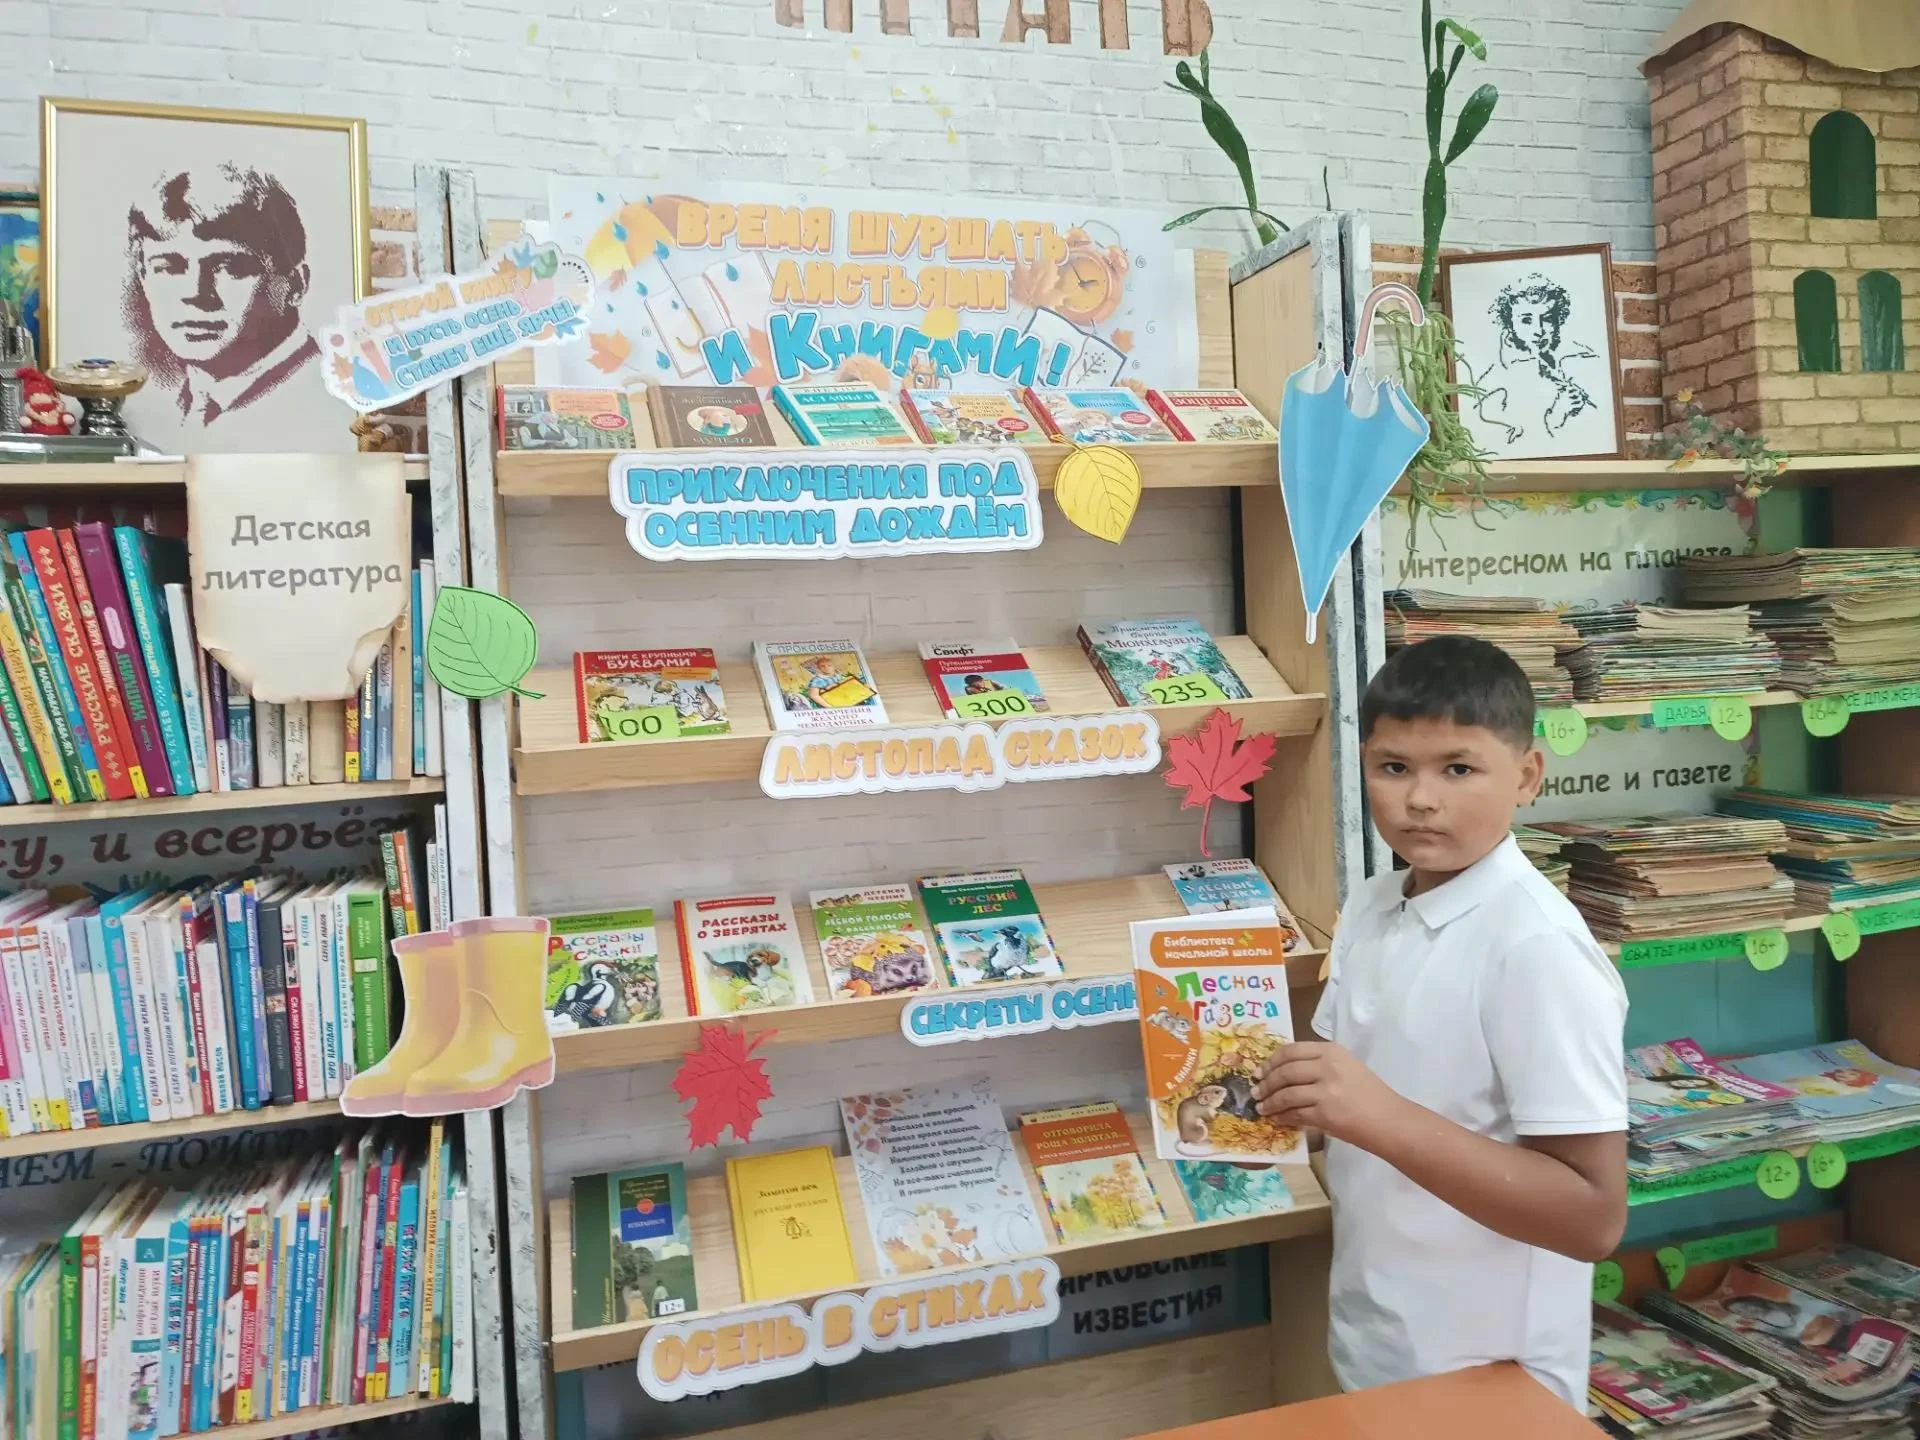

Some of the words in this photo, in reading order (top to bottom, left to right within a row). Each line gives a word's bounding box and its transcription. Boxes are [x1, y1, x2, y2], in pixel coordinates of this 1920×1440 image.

[675, 203, 835, 254] ВРЕМЯ
[849, 212, 1069, 266] ШУРШАТЬ
[771, 261, 1010, 312] ЛИСТЬЯМИ
[386, 335, 405, 356] И
[406, 317, 462, 349] ПУСТЬ
[464, 299, 521, 329] ОСЕНЬ
[396, 343, 469, 387] СТАНЕТ
[517, 299, 575, 337] ЯРЧЕ!
[627, 463, 928, 504] ПРИКЛЮЧЕНИЯ
[938, 461, 1023, 498] ПОД
[231, 514, 371, 546] Детская
[644, 510, 837, 548] ОСЕННИМ
[850, 498, 1027, 543] ДОЖДЁМ
[202, 562, 402, 595] литература
[1399, 551, 1568, 585] интересном
[1580, 550, 1611, 572] на
[45, 582, 82, 660] СКАЗКИ
[776, 642, 856, 654] ПРОКОФЬЕВА
[932, 647, 976, 658] Свифт
[606, 658, 691, 670] БУКВАМИ
[111, 650, 147, 722] КИПЛИНГ
[1151, 680, 1209, 705] 235
[73, 662, 112, 746] РУССКИЕ
[967, 694, 1027, 717] 300
[1718, 706, 1744, 725] 12+
[599, 713, 662, 738] 100
[1550, 720, 1577, 739] 16+
[774, 734, 995, 786] ЛИСТОПАД
[1002, 721, 1149, 768] СКАЗОК
[1624, 771, 1640, 791] и
[1653, 762, 1733, 789] газете
[91, 832, 130, 864] и
[947, 890, 1018, 905] РУССКИЙ
[1198, 881, 1257, 893] ЛЕСНЫЕ
[702, 912, 780, 928] РАССКАЗЫ
[971, 904, 1004, 915] ЛЕС
[697, 930, 707, 940] О
[712, 922, 788, 938] ЗВЕРЯТАХ
[1163, 936, 1235, 948] Библиотека
[1165, 948, 1230, 960] начальной
[1231, 947, 1274, 958] школы
[1174, 971, 1277, 1001] Лесная
[289, 996, 300, 1027] СКАЗКИ
[910, 992, 1044, 1036] СЕКРЕТЫ
[292, 1029, 303, 1066] НАРОДОВ
[326, 1021, 335, 1058] НАХОДОК
[214, 1046, 225, 1071] Носов
[216, 1074, 228, 1109] Николай
[295, 1067, 305, 1089] МИРА
[1764, 1166, 1792, 1184] 12+
[653, 1313, 807, 1384] ОСЕНЬ
[821, 1304, 855, 1350] В
[869, 1266, 1048, 1341] СТИХАХ
[1073, 1284, 1224, 1335] ИЗВЕСТИЯ
